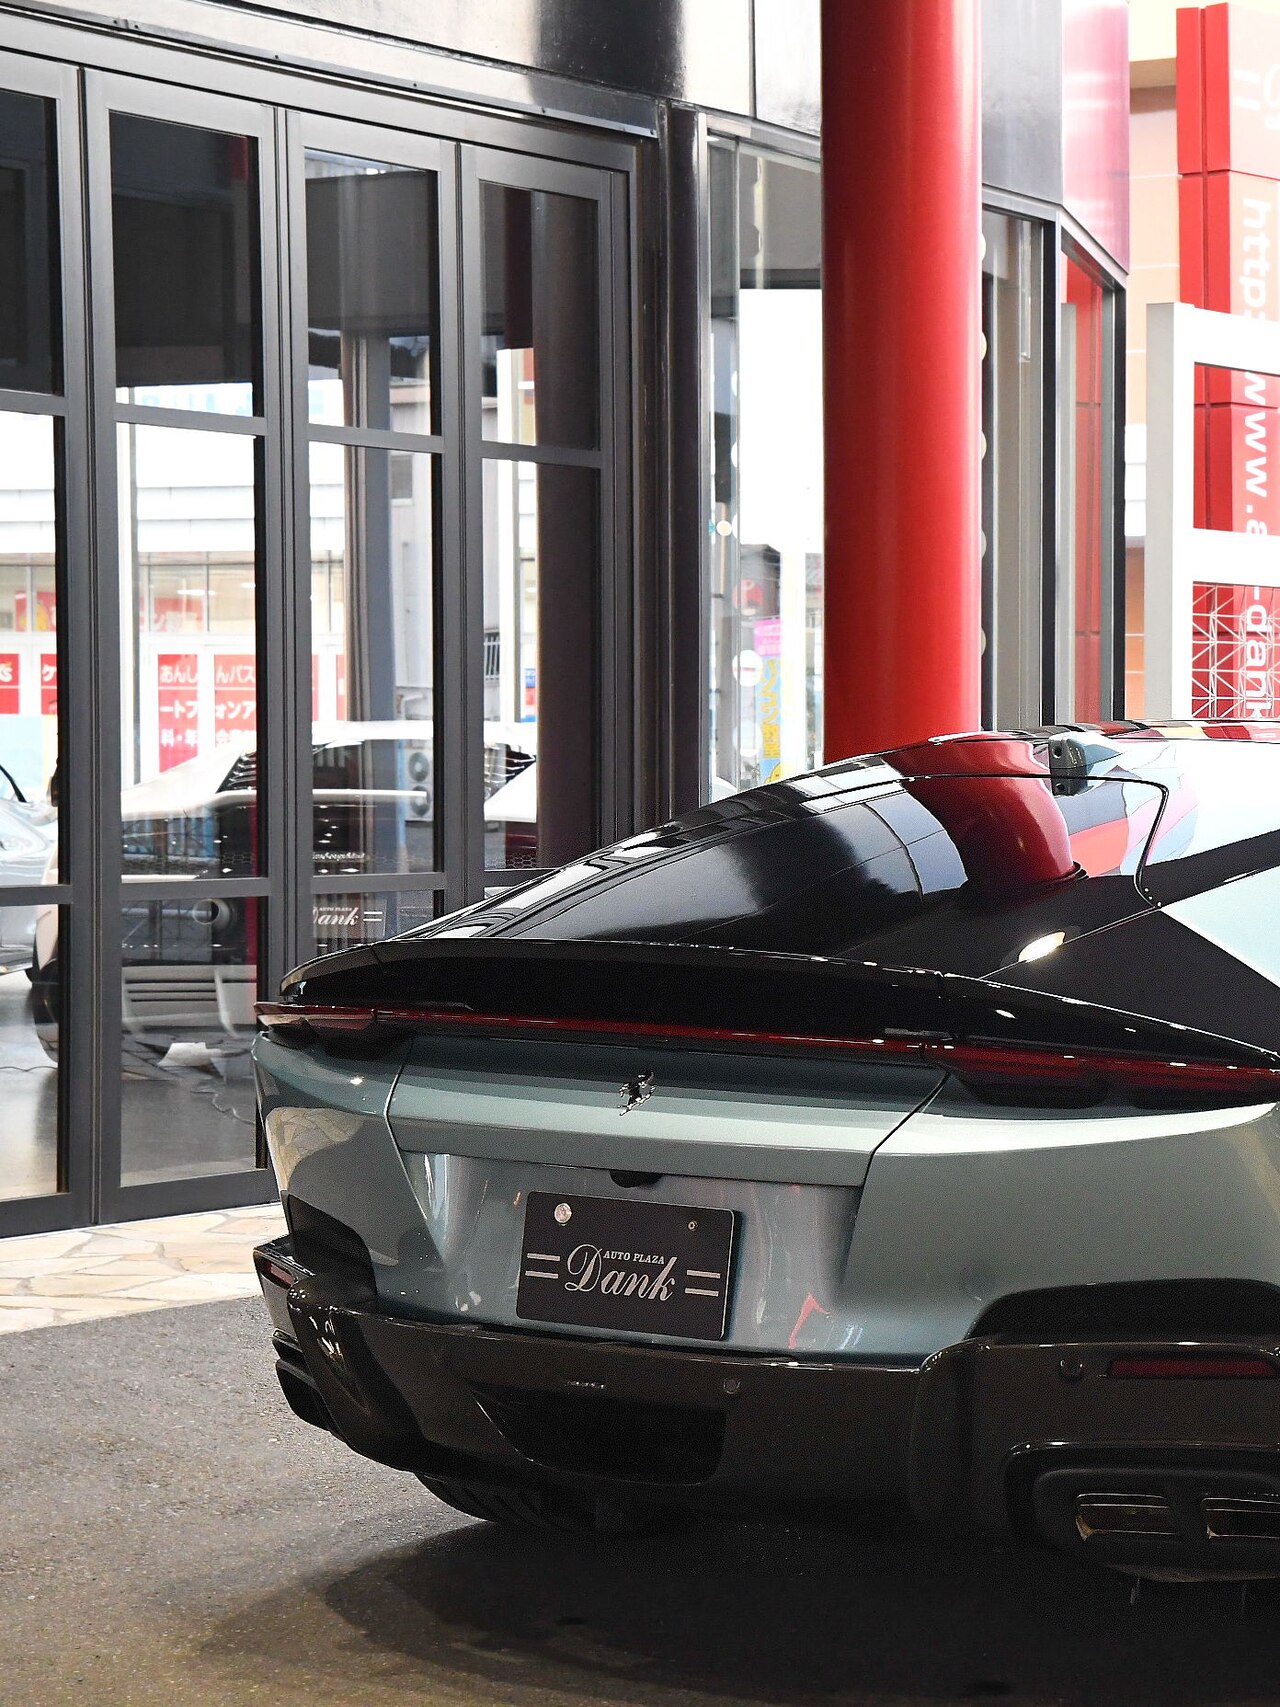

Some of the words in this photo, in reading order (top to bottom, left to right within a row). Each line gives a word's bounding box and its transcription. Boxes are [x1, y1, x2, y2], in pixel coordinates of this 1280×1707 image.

[564, 1243, 678, 1302] Dank
[603, 1250, 631, 1261] AUTO
[633, 1253, 665, 1265] PLAZA
